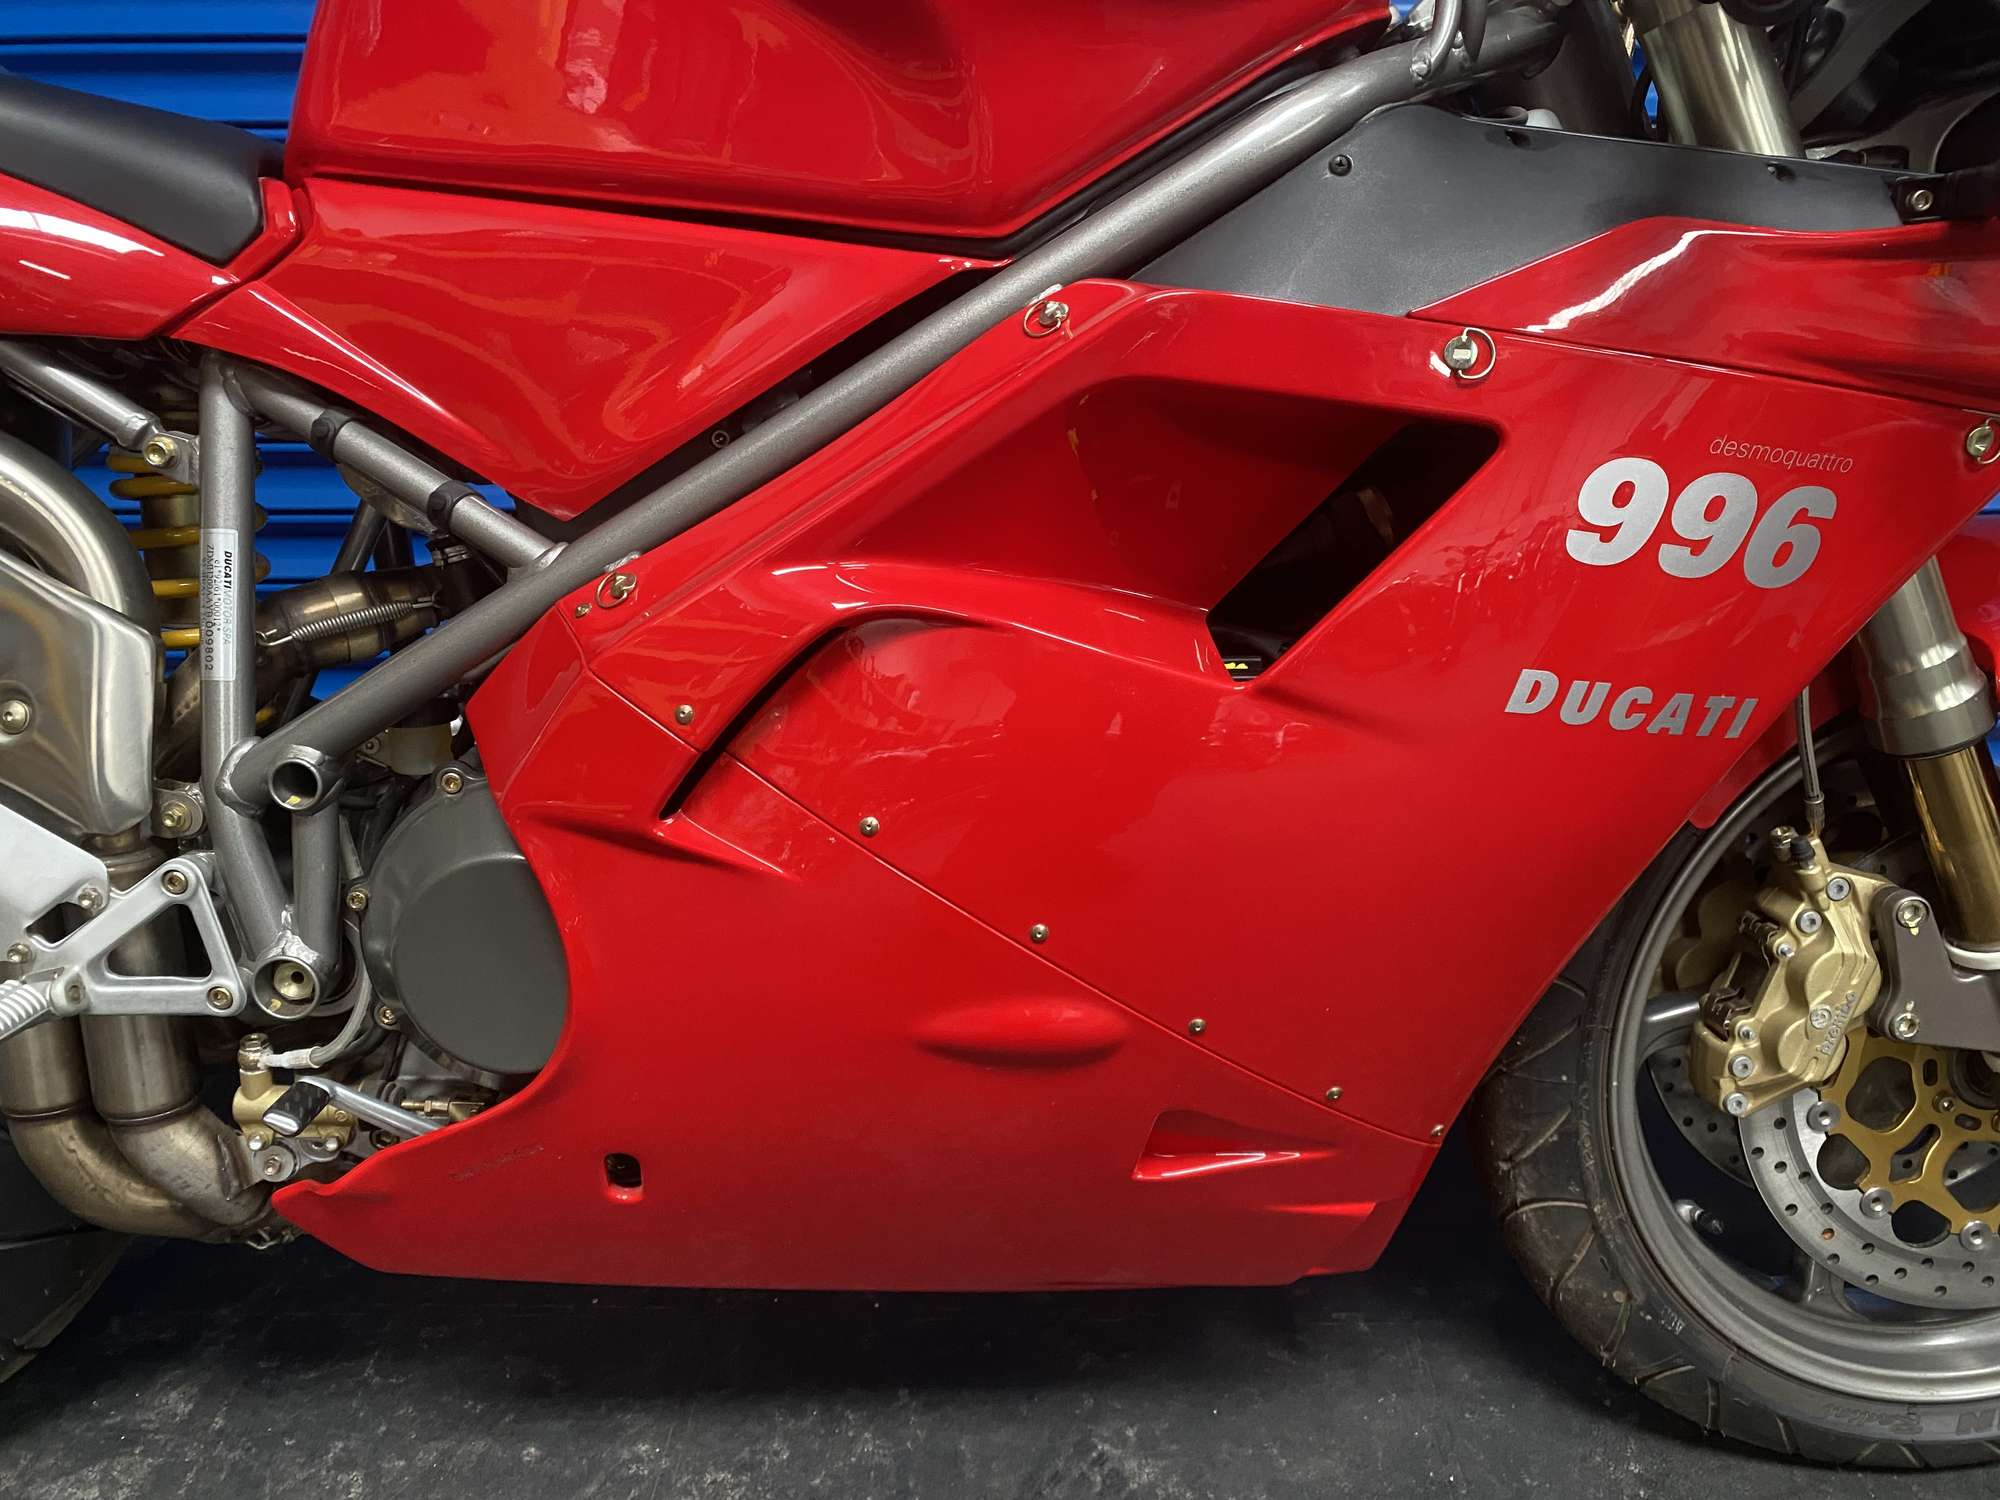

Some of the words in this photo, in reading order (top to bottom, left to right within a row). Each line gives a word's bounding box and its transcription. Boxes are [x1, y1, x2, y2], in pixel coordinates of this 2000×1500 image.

[1709, 434, 1854, 473] desmoquattro
[1565, 456, 1838, 589] 996
[1504, 668, 1759, 739] DUCATI
[1816, 989, 1857, 1056] brembo
